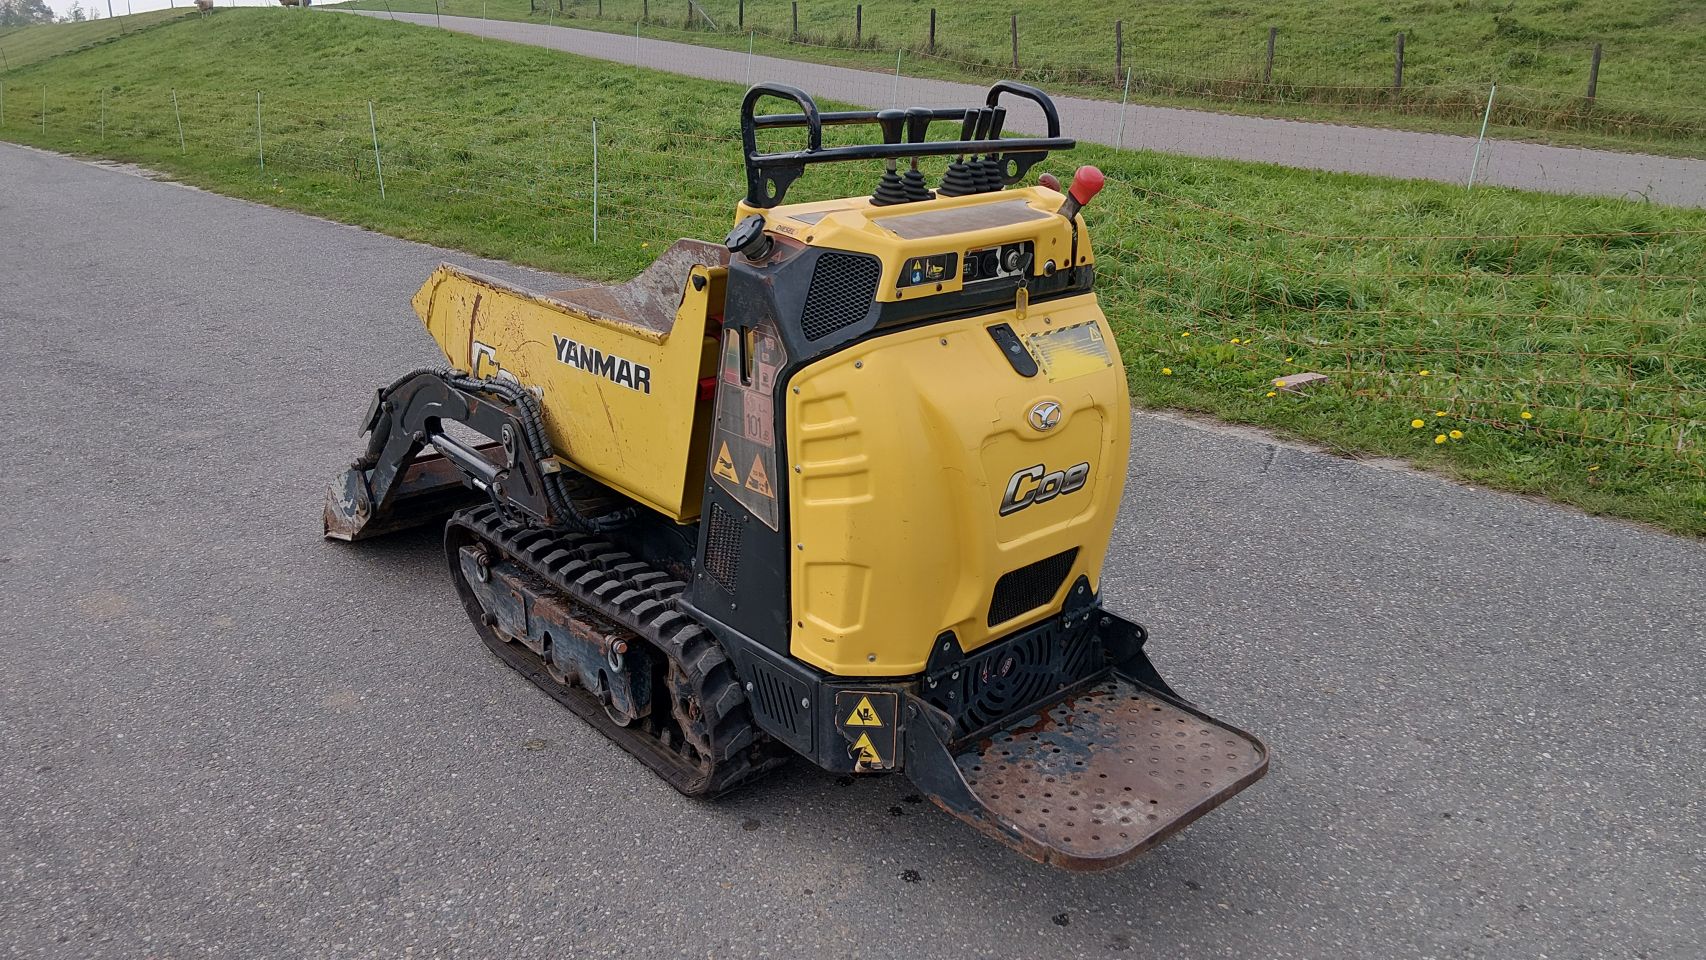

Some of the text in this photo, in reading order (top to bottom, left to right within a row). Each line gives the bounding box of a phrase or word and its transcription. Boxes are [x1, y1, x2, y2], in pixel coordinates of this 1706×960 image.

[776, 224, 796, 235] DIESEL
[552, 334, 651, 394] YANMAR
[747, 414, 762, 439] 101
